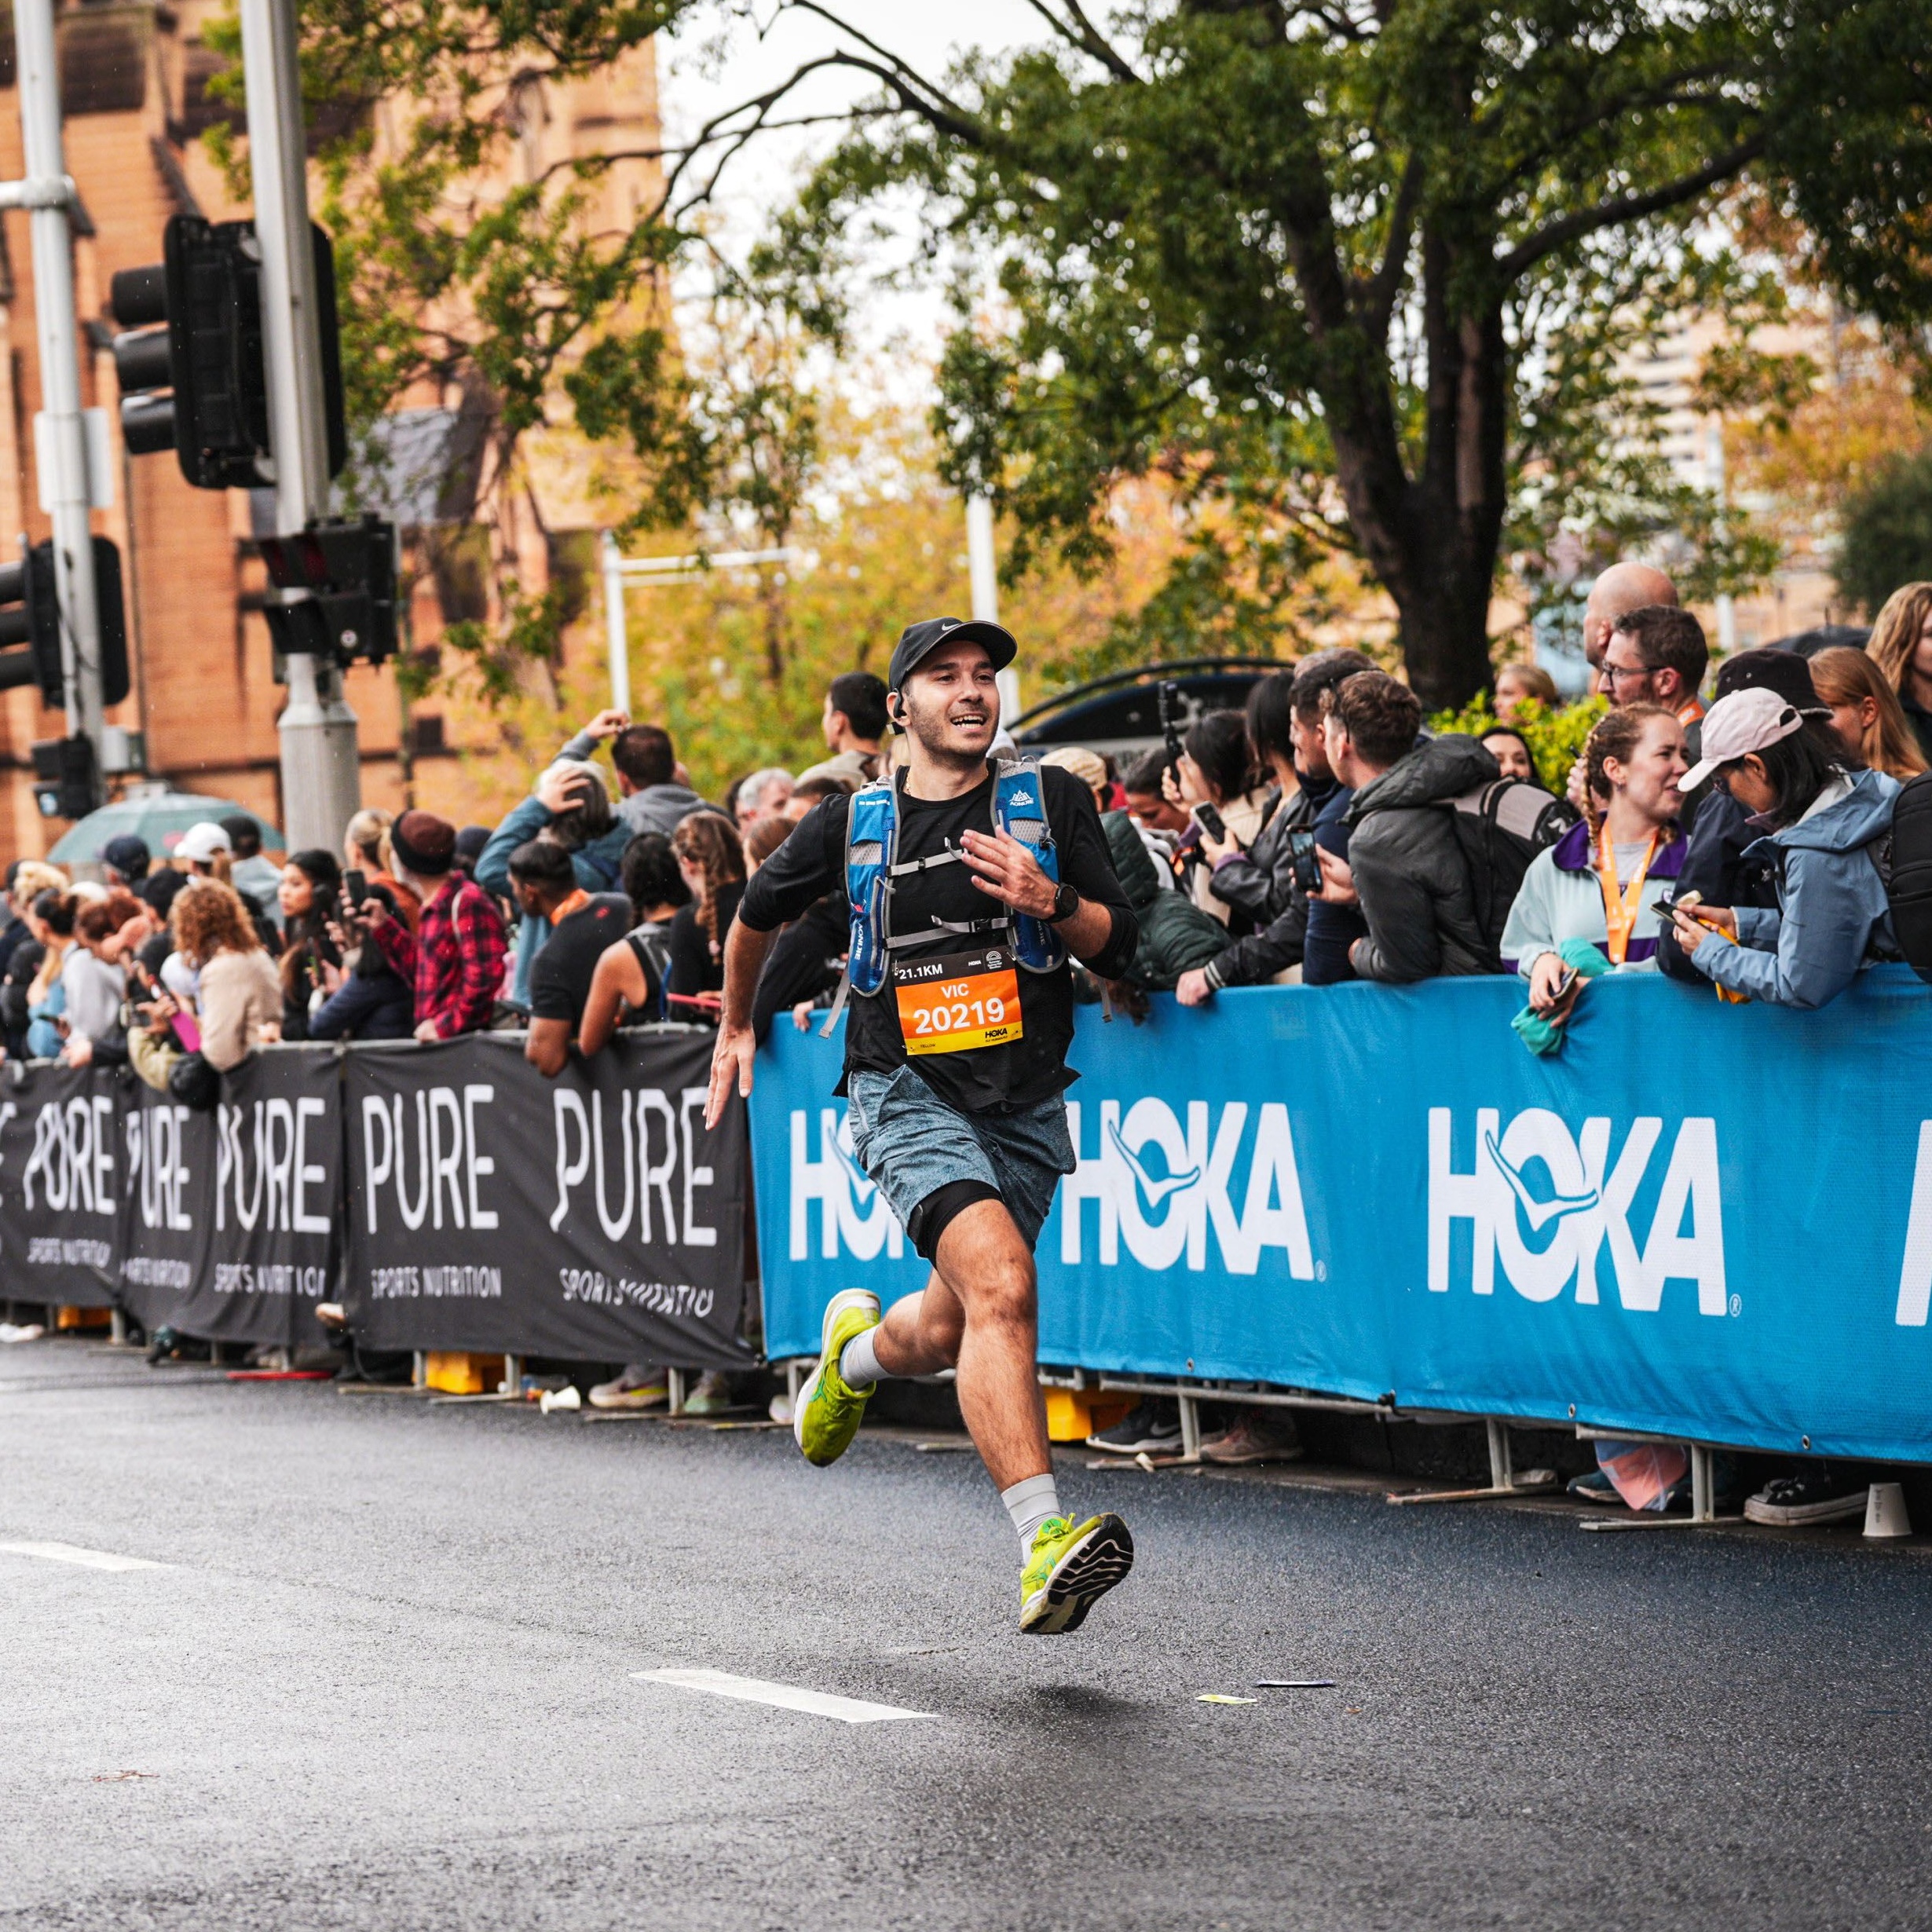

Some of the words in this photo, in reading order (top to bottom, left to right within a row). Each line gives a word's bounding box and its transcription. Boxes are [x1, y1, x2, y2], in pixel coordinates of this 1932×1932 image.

[899, 964, 943, 980] 21.1KM
[913, 997, 1004, 1034] 20219
[941, 983, 969, 999] VIC
[985, 1027, 1008, 1038] HOKA
[23, 1095, 116, 1216] PURE
[126, 1105, 192, 1231] PURE
[216, 1097, 331, 1235] PURE
[362, 1084, 499, 1235] PURE
[550, 1086, 718, 1246] PURE
[789, 1107, 904, 1261] HO
[1061, 1097, 1315, 1281] HOKA
[1428, 1107, 1728, 1316] HOKA
[371, 1266, 419, 1300] SPORTS
[423, 1265, 502, 1298] NUTRITION
